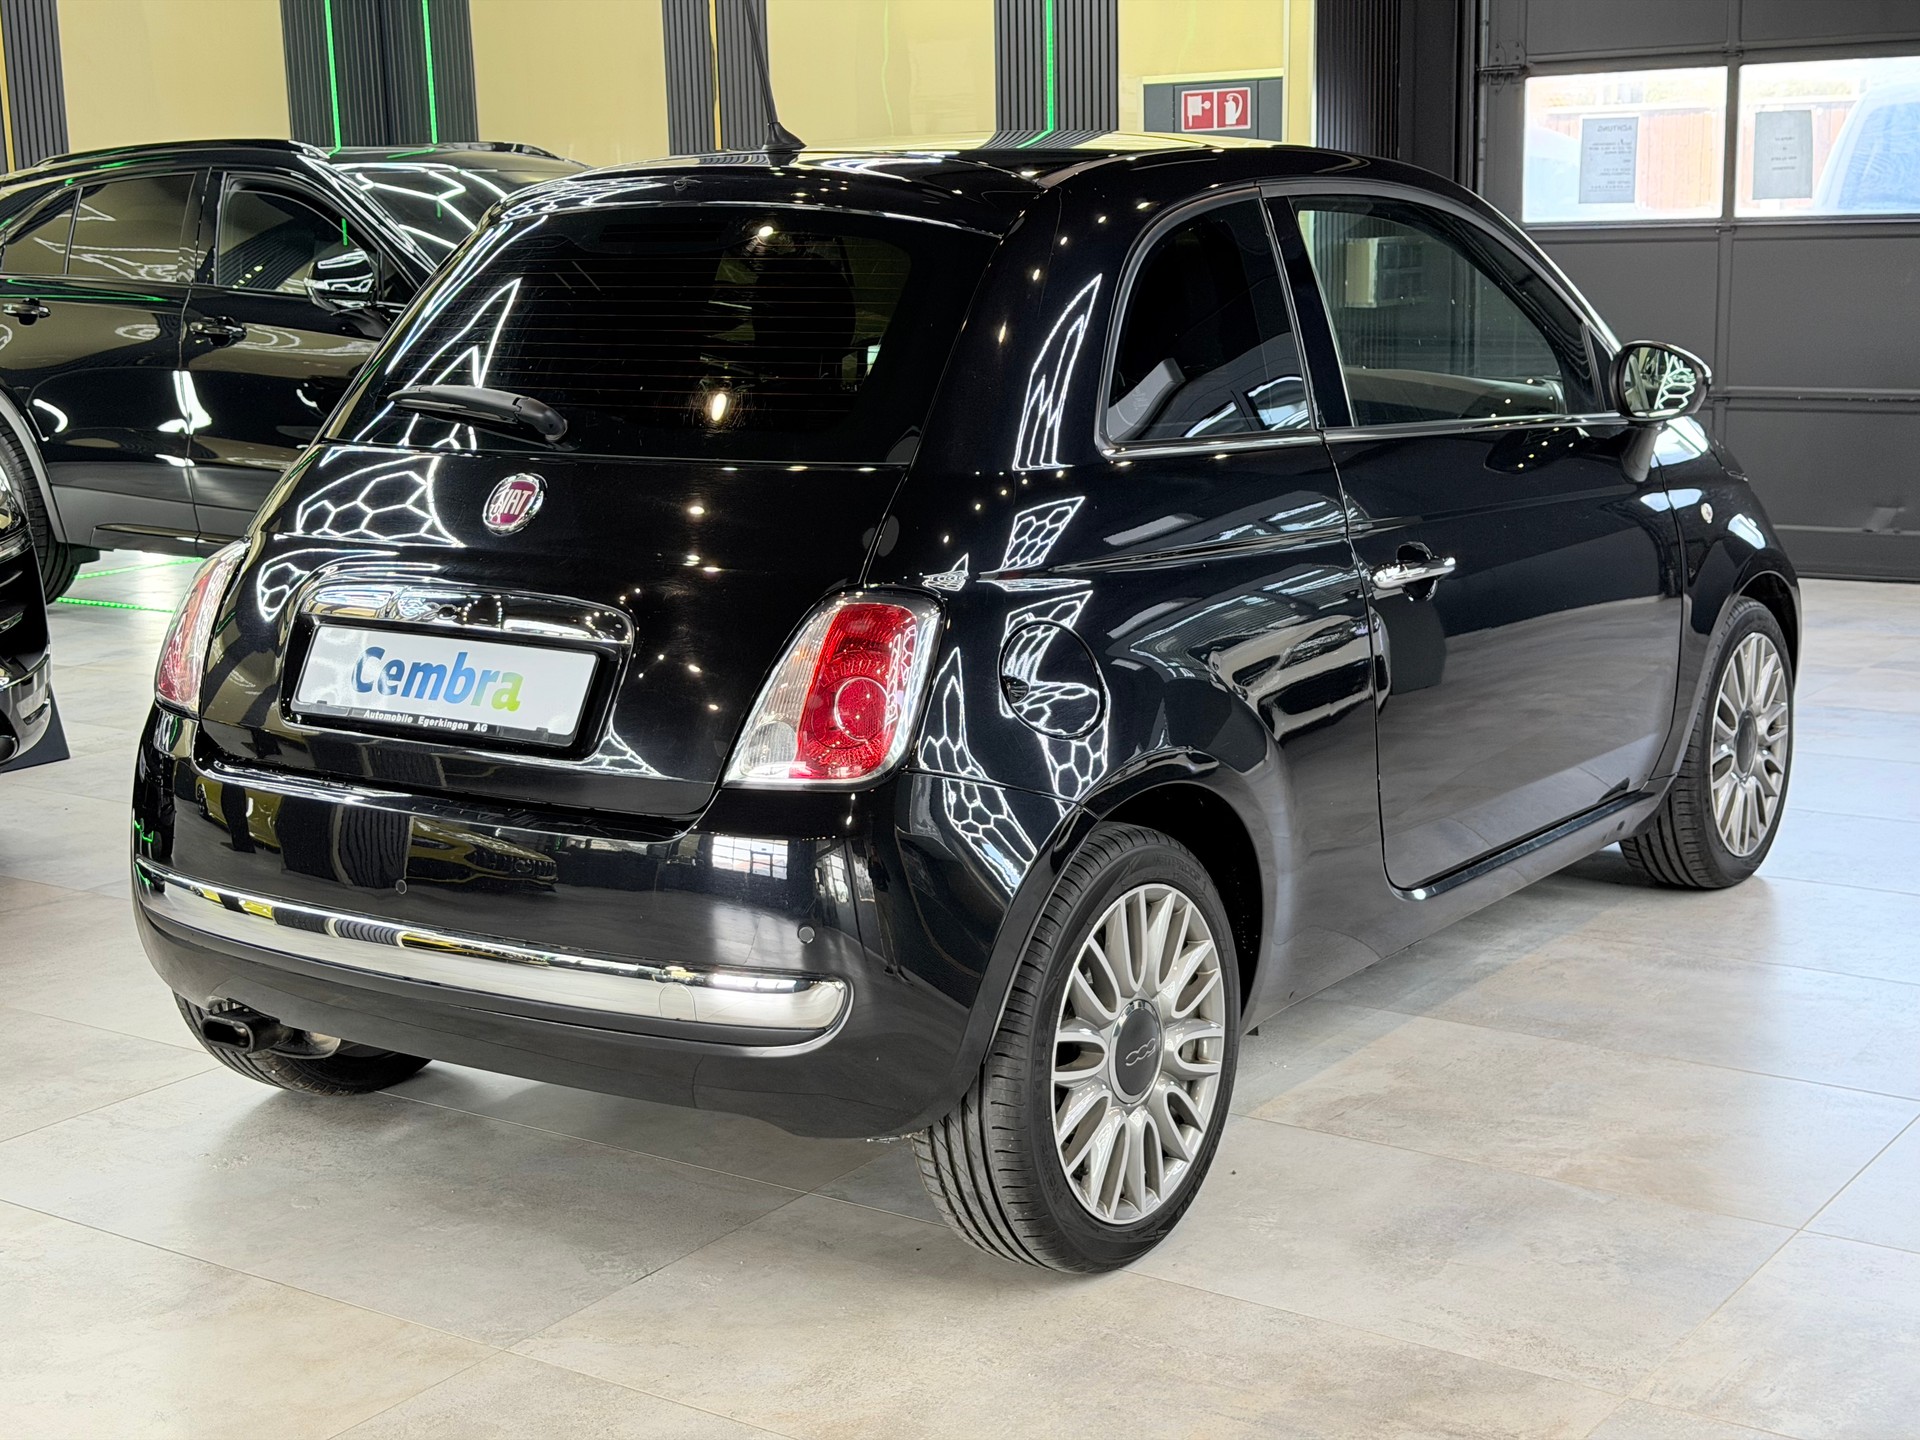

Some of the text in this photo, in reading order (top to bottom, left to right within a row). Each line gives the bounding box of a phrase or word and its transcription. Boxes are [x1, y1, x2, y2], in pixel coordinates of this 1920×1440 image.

[352, 646, 524, 711] Cembra
[363, 709, 488, 732] Automobile Egerkingen AG
